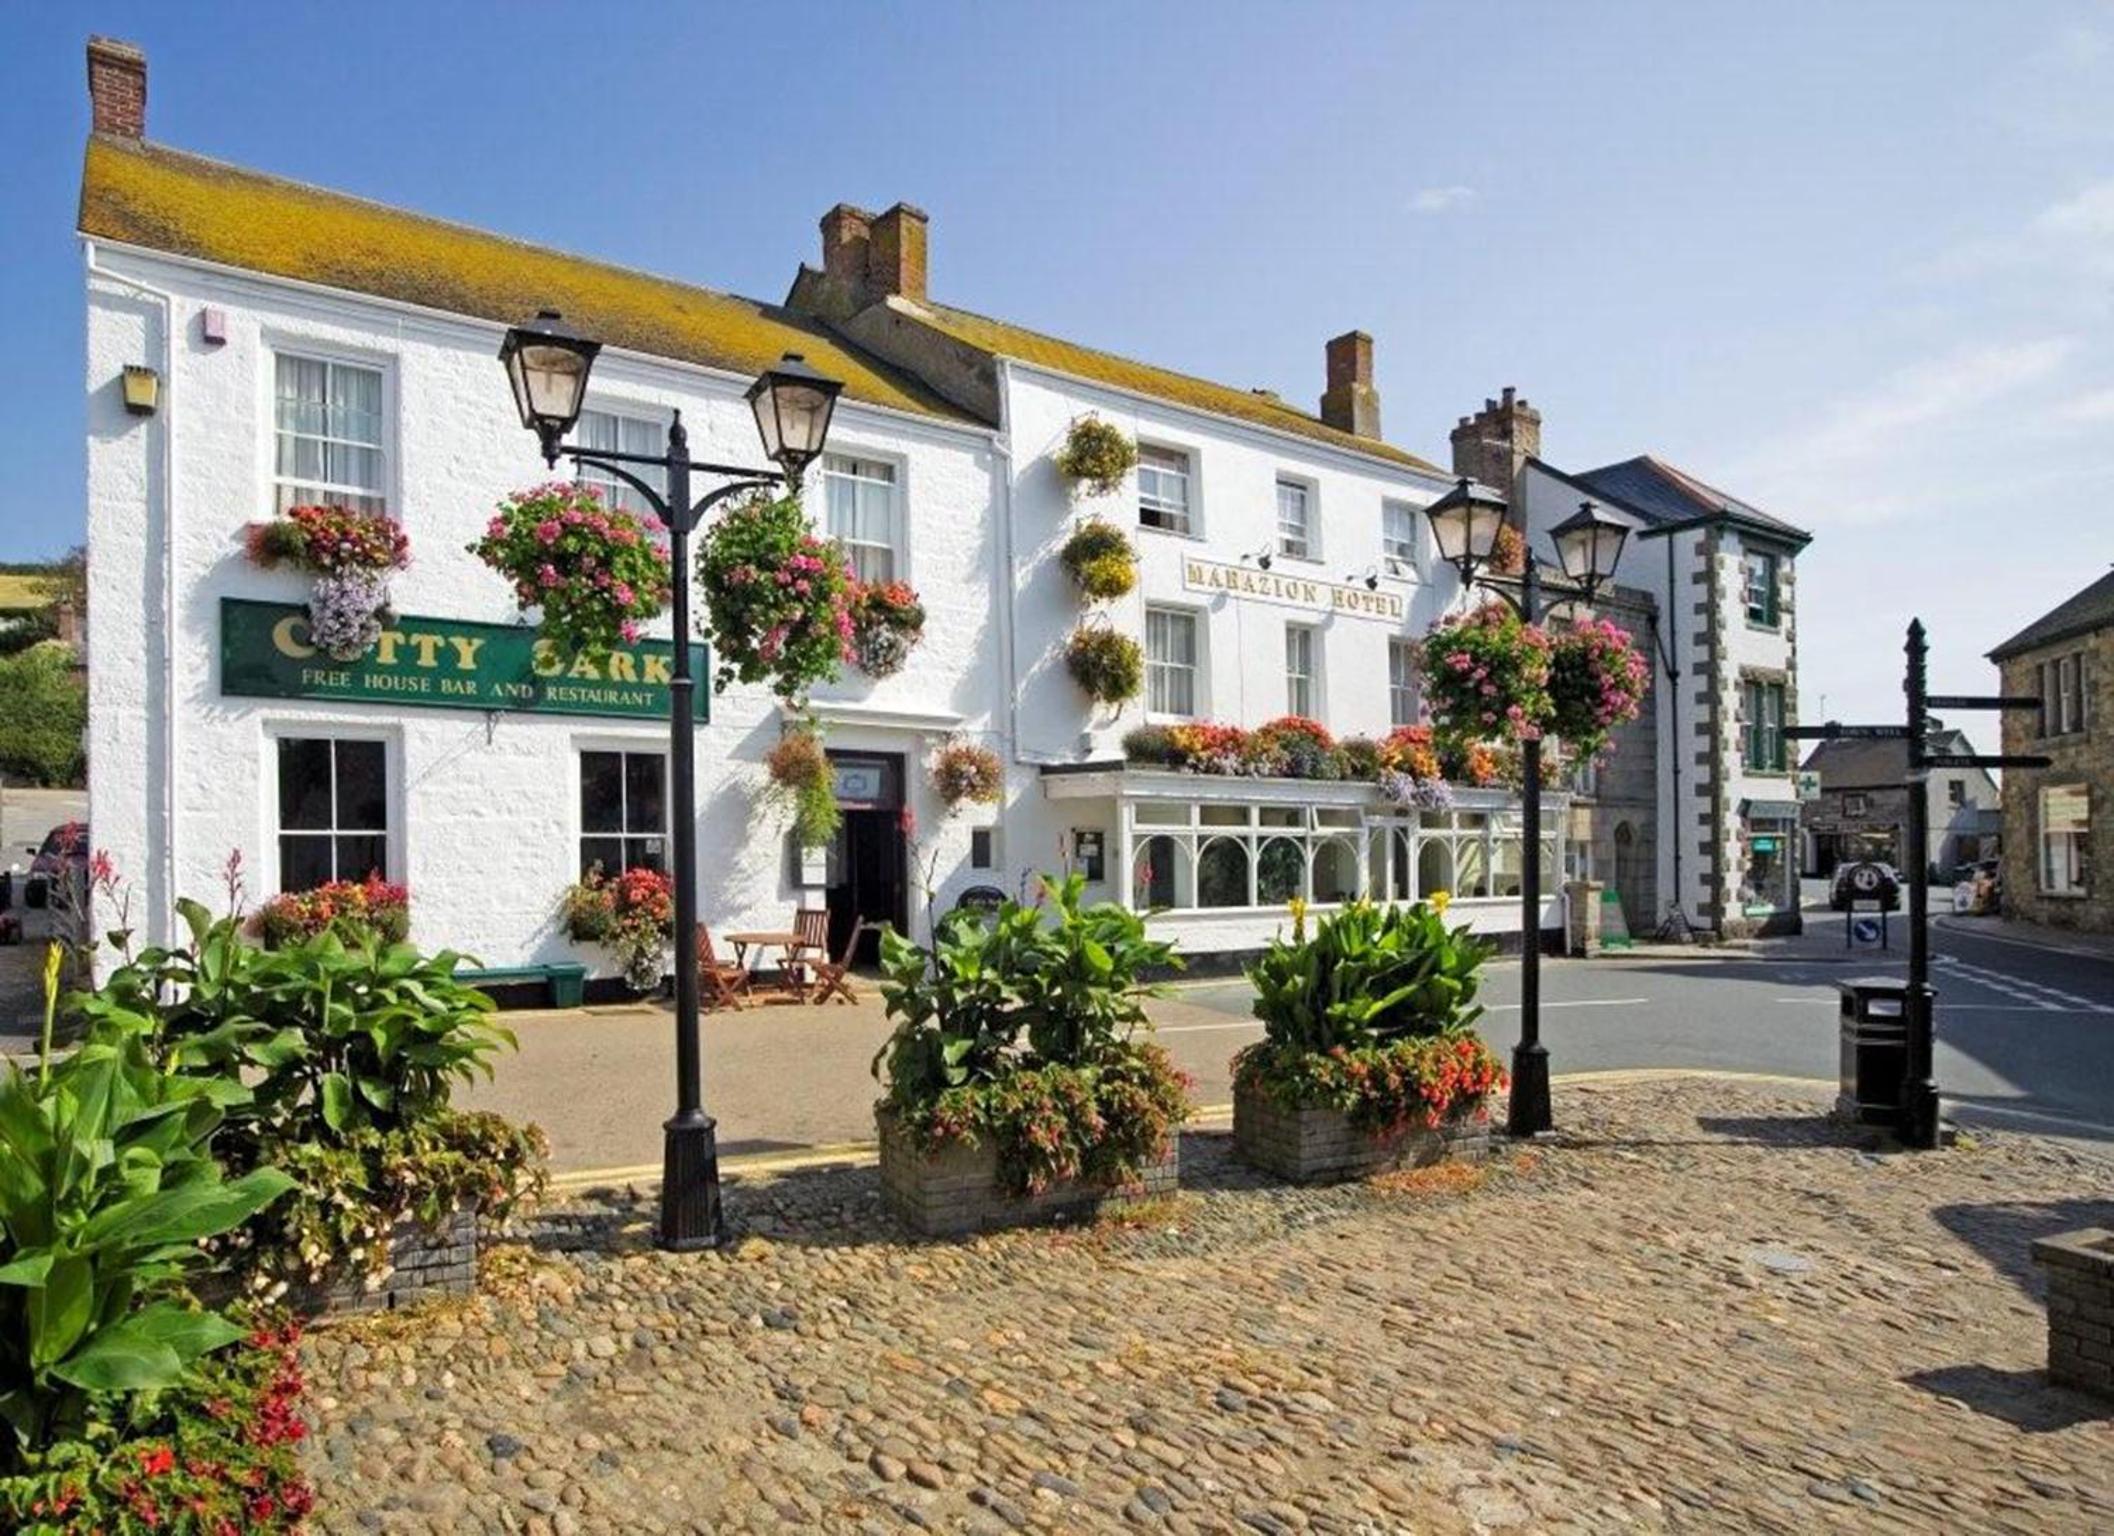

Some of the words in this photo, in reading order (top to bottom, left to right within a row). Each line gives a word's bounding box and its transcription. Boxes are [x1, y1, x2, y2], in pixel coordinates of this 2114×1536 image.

[1187, 563, 1317, 602] MARAZION
[1331, 587, 1402, 617] HOTEL
[272, 615, 485, 670] CTTY
[302, 668, 352, 687] FREE
[364, 674, 431, 692] HOUSE
[441, 679, 478, 695] BAR
[490, 683, 534, 699] AND
[547, 685, 655, 706] RESTAURANT
